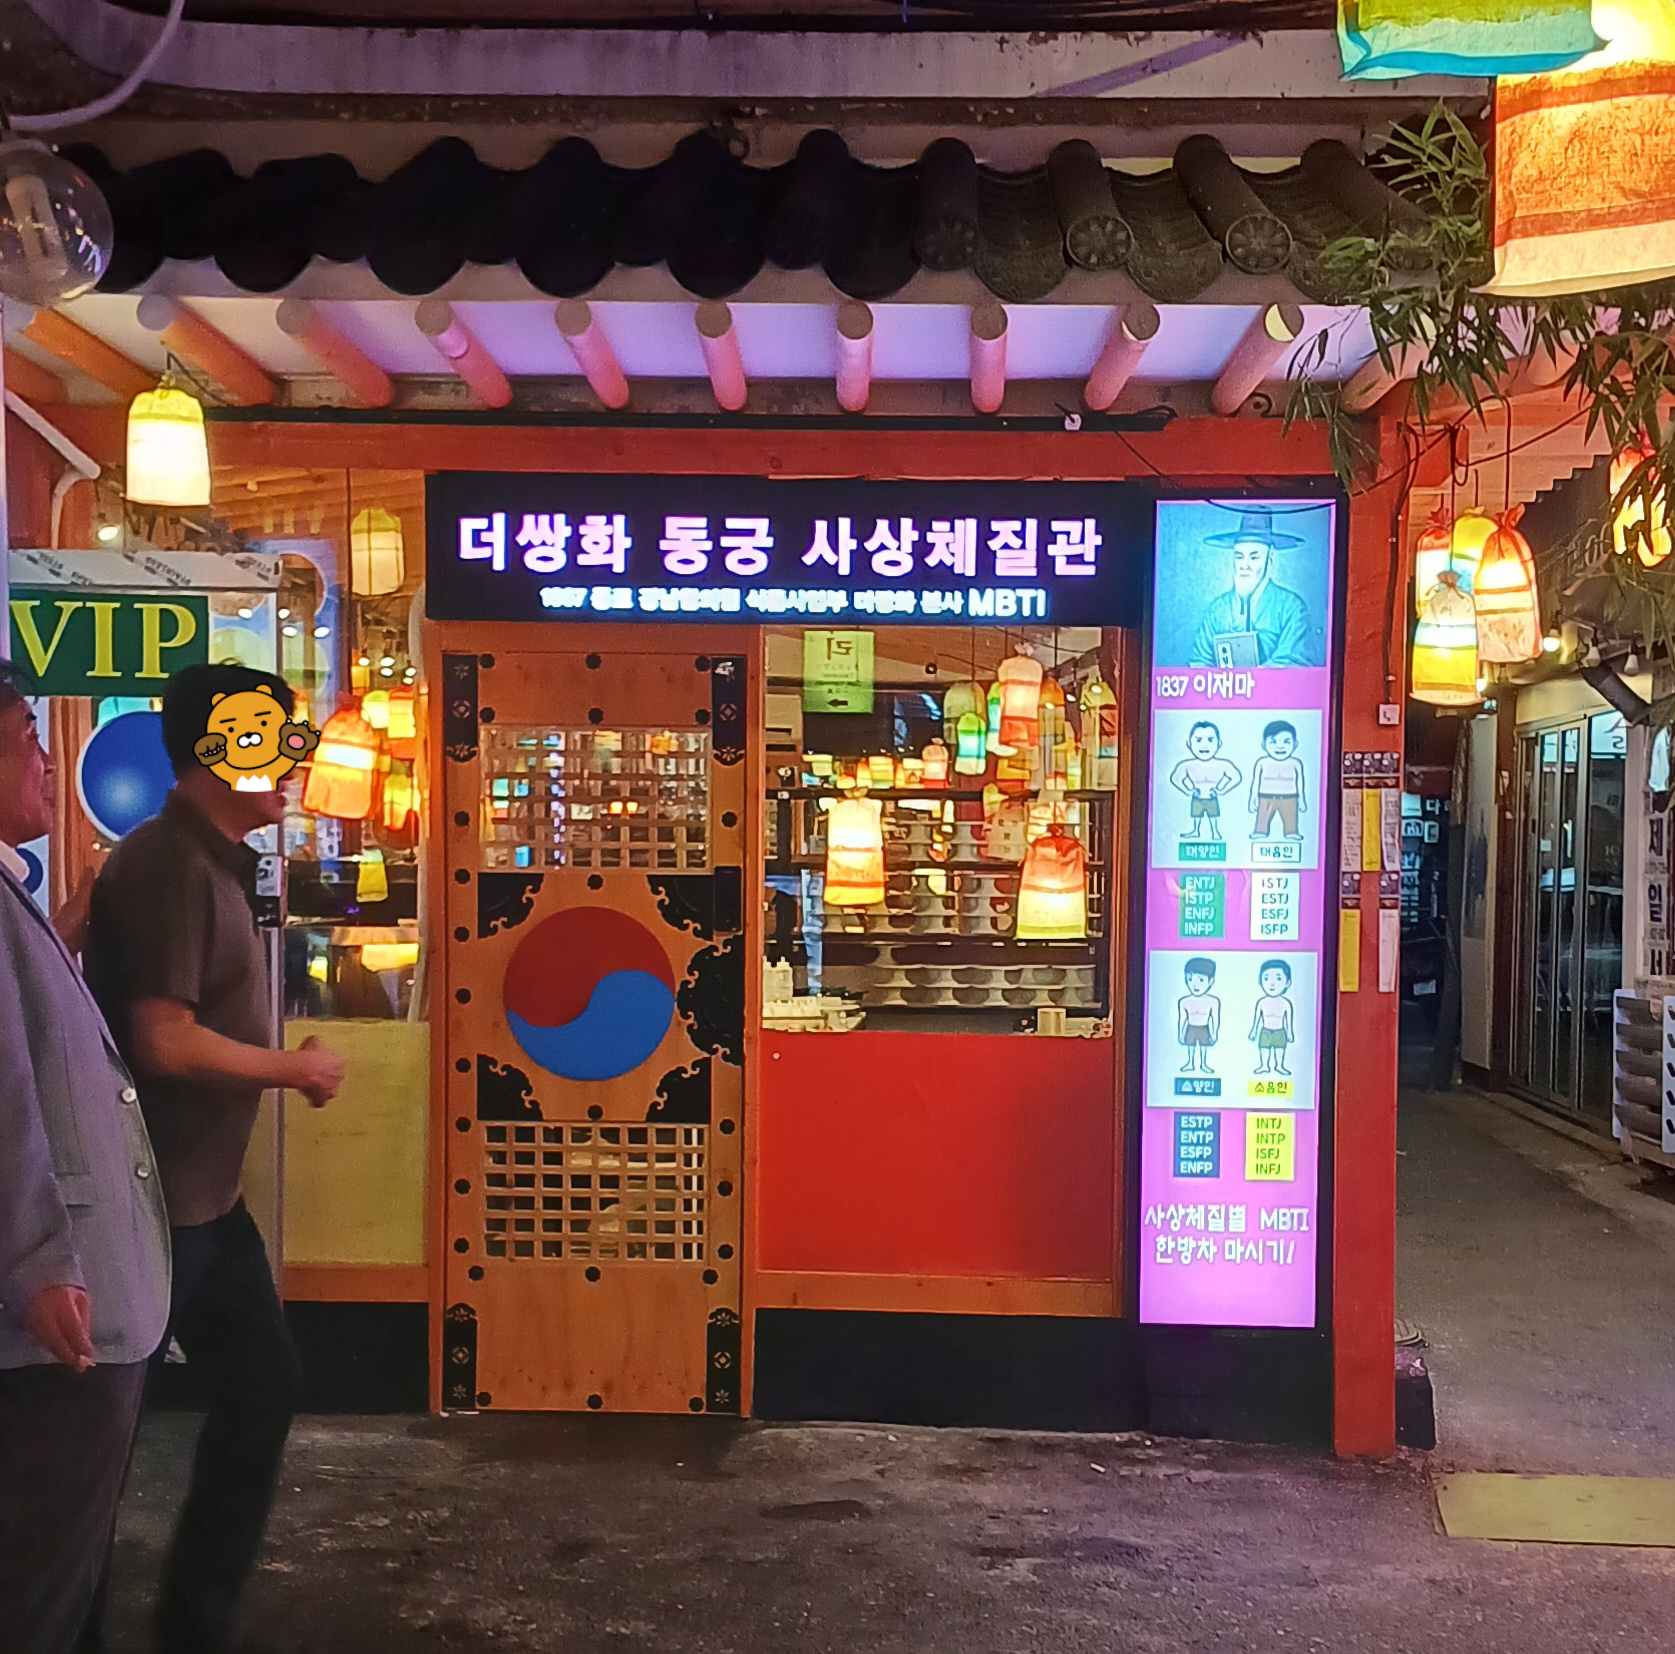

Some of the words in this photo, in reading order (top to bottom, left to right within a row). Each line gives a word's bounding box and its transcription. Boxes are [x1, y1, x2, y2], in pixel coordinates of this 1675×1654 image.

[459, 512, 632, 573] 더쌍화
[659, 516, 775, 575] 동궁
[801, 517, 1103, 576] 사상체질관
[968, 588, 1047, 616] MBTI
[9, 600, 197, 679] VIP
[1156, 676, 1189, 697] 1837
[1193, 671, 1256, 699] 이재마
[1185, 876, 1215, 890] ENTJ
[1261, 877, 1289, 889] ISTJ
[1185, 891, 1214, 904] ISTP
[1261, 892, 1289, 904] ESTJ
[1184, 906, 1215, 920] ENFJ
[1261, 908, 1289, 920] ESFJ
[1184, 922, 1214, 935] INFP
[1261, 923, 1289, 935] ISFP
[1180, 1115, 1213, 1129] ESTP
[1256, 1117, 1282, 1129] INTJ
[1180, 1131, 1214, 1144] ENTP
[1256, 1132, 1286, 1144] INTP
[1180, 1146, 1212, 1158] ESFP
[1256, 1148, 1280, 1159] ISFJ
[1180, 1161, 1213, 1174] ENFP
[1255, 1163, 1281, 1175] INFJ
[1144, 1202, 1247, 1233] 사상체질별
[1260, 1207, 1310, 1231] MBTI
[1155, 1235, 1217, 1265] 한방차
